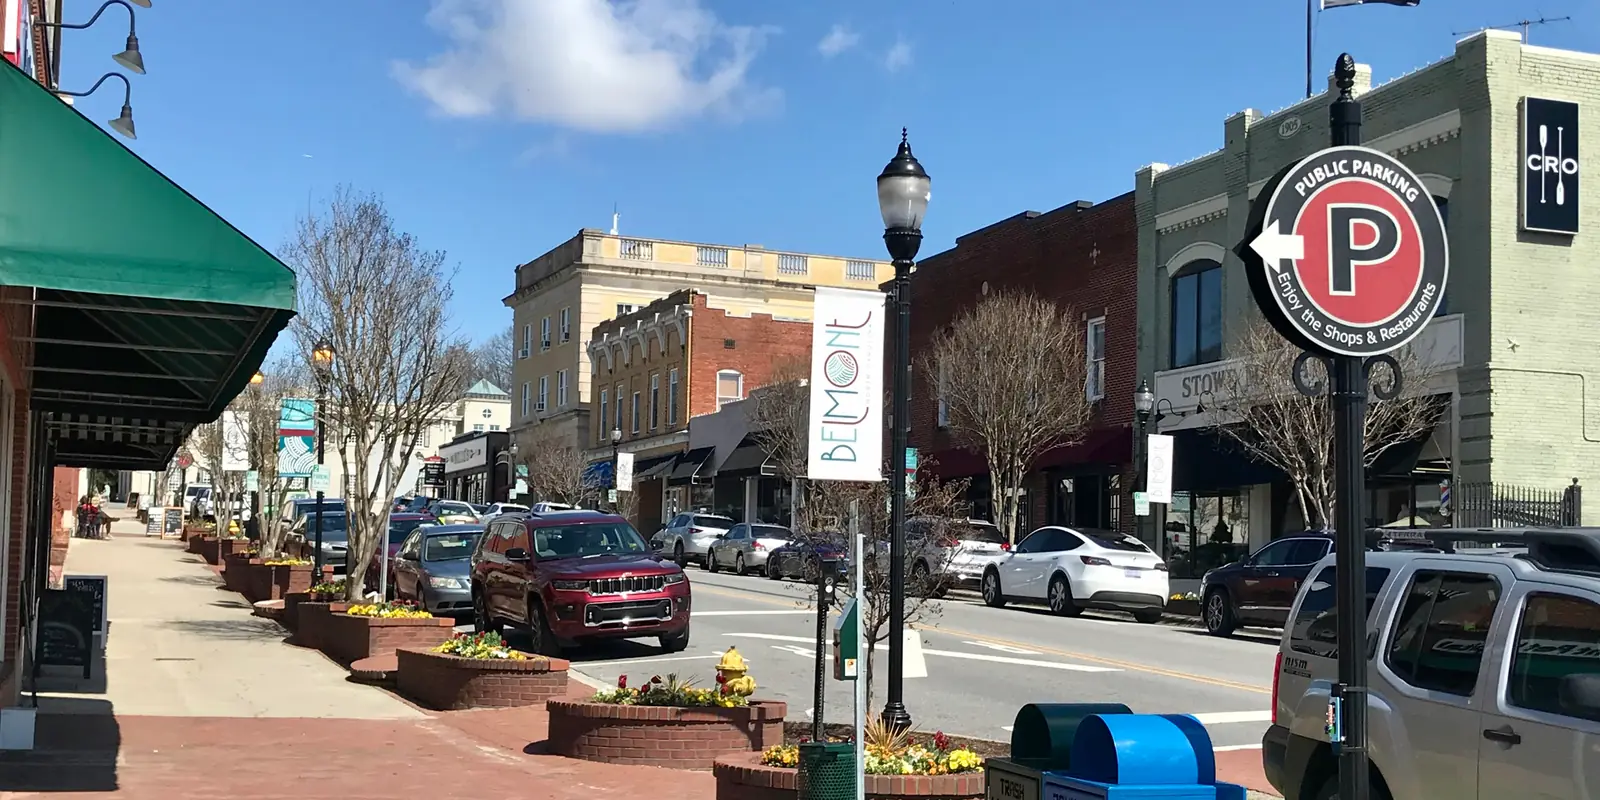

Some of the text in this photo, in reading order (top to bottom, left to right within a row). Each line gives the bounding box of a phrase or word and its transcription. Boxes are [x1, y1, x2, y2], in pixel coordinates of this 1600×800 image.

[1281, 119, 1298, 134] 1905
[1294, 159, 1420, 203] PUBLIC PARKING
[1527, 154, 1578, 175] CRO
[1326, 203, 1402, 296] P
[1277, 272, 1436, 347] Enjoy the Shops & Restaurants
[1000, 778, 1025, 800] TRASH
